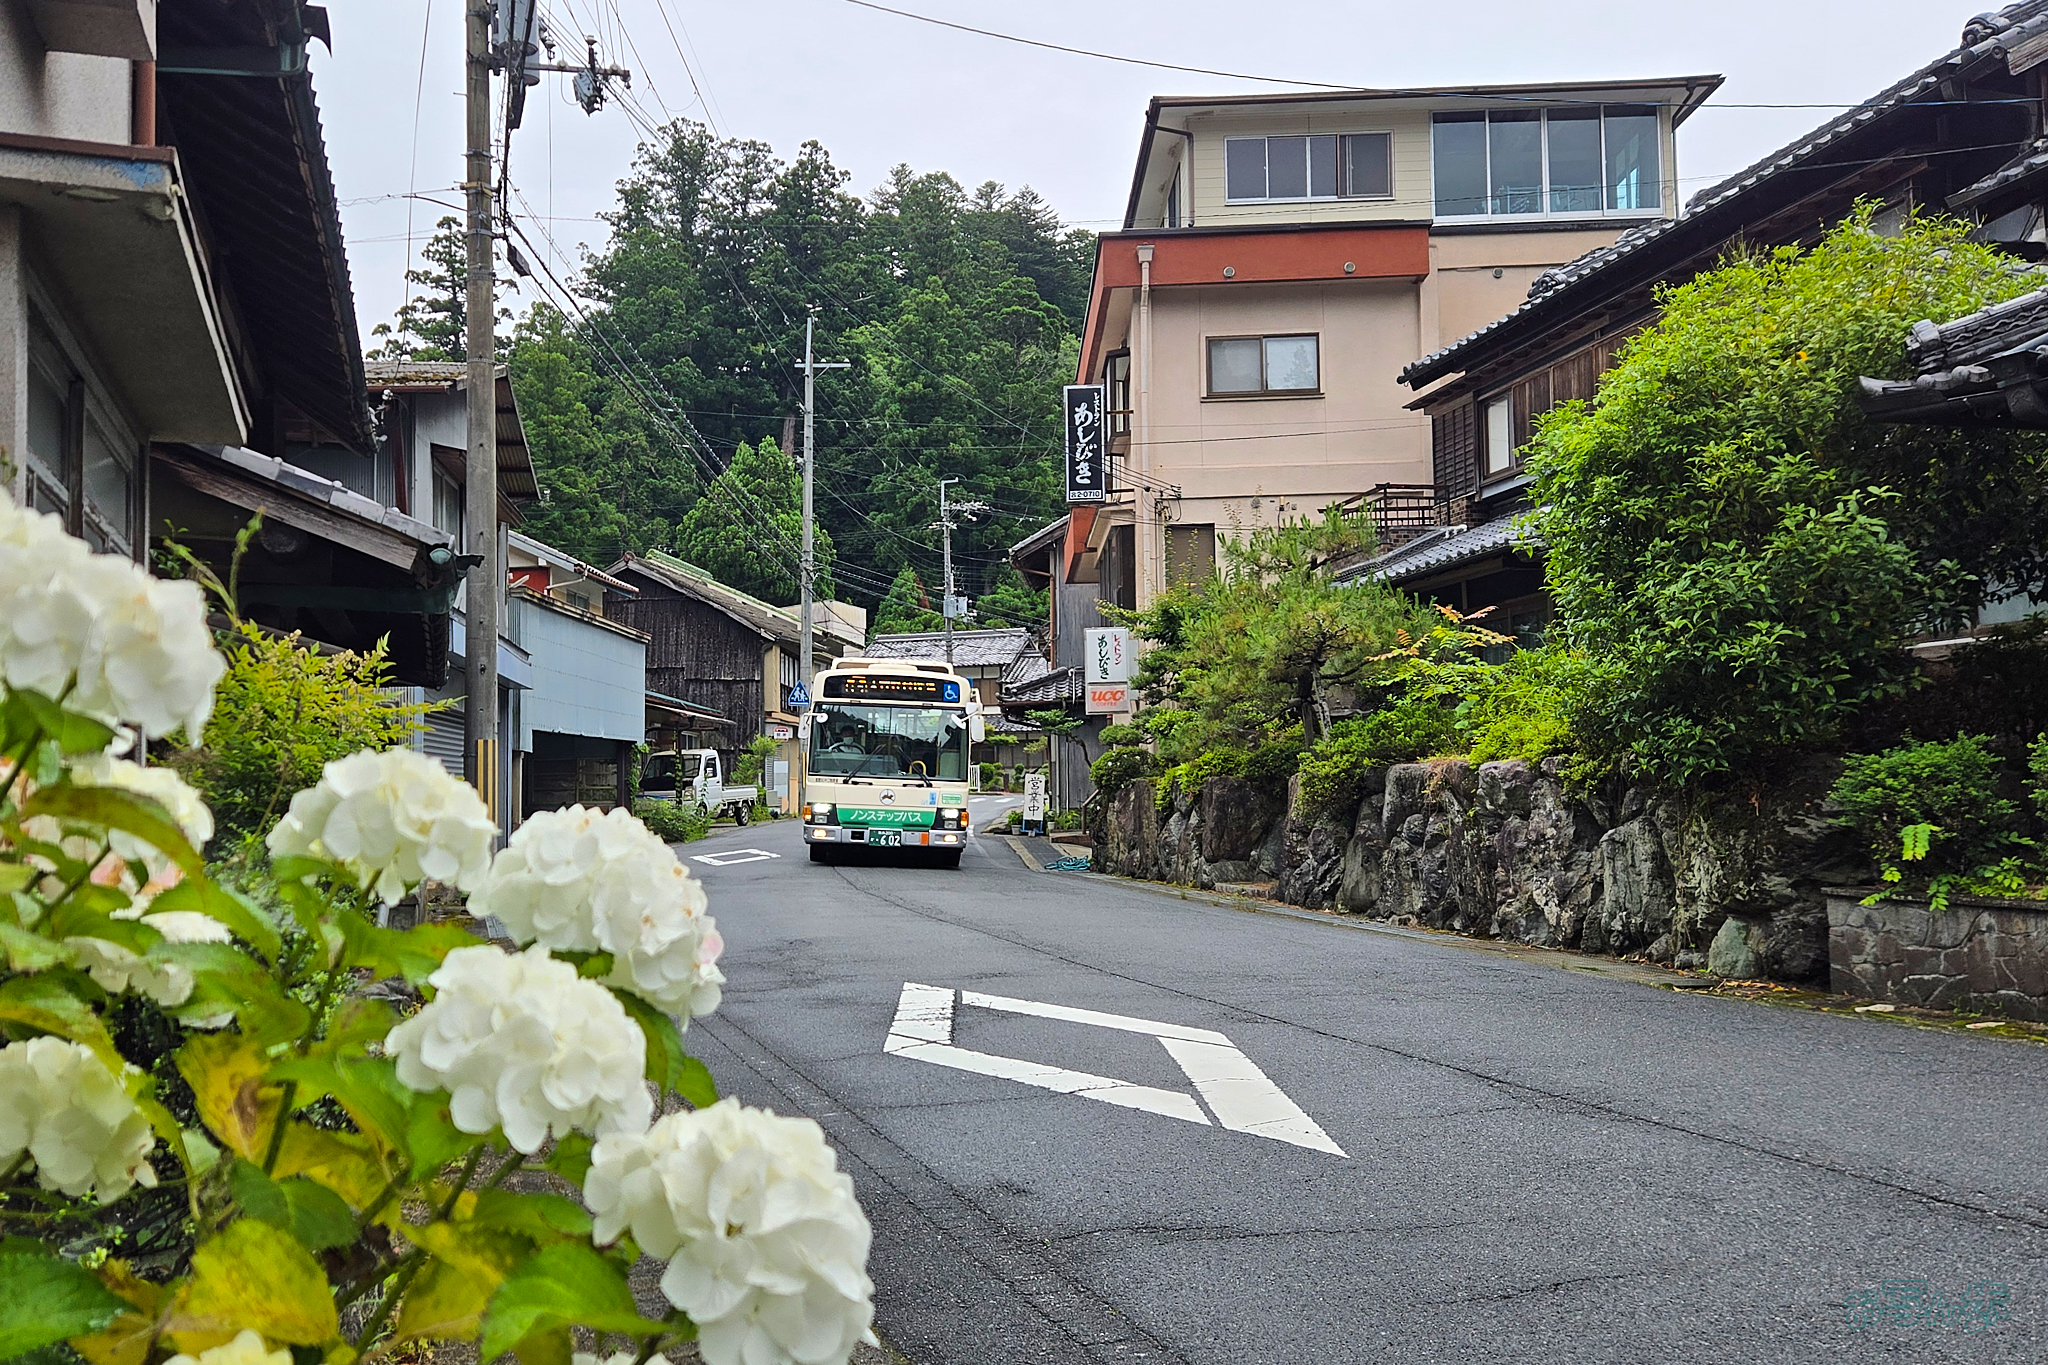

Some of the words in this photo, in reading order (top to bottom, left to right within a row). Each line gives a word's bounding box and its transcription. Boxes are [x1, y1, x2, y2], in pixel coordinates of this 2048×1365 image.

[1093, 392, 1101, 427] レストラン
[1074, 402, 1098, 484] あしびき
[1097, 633, 1110, 680] あしびき
[1113, 634, 1122, 666] レストラン
[1027, 777, 1042, 817] 営業中
[850, 810, 922, 823] ノンステップバス
